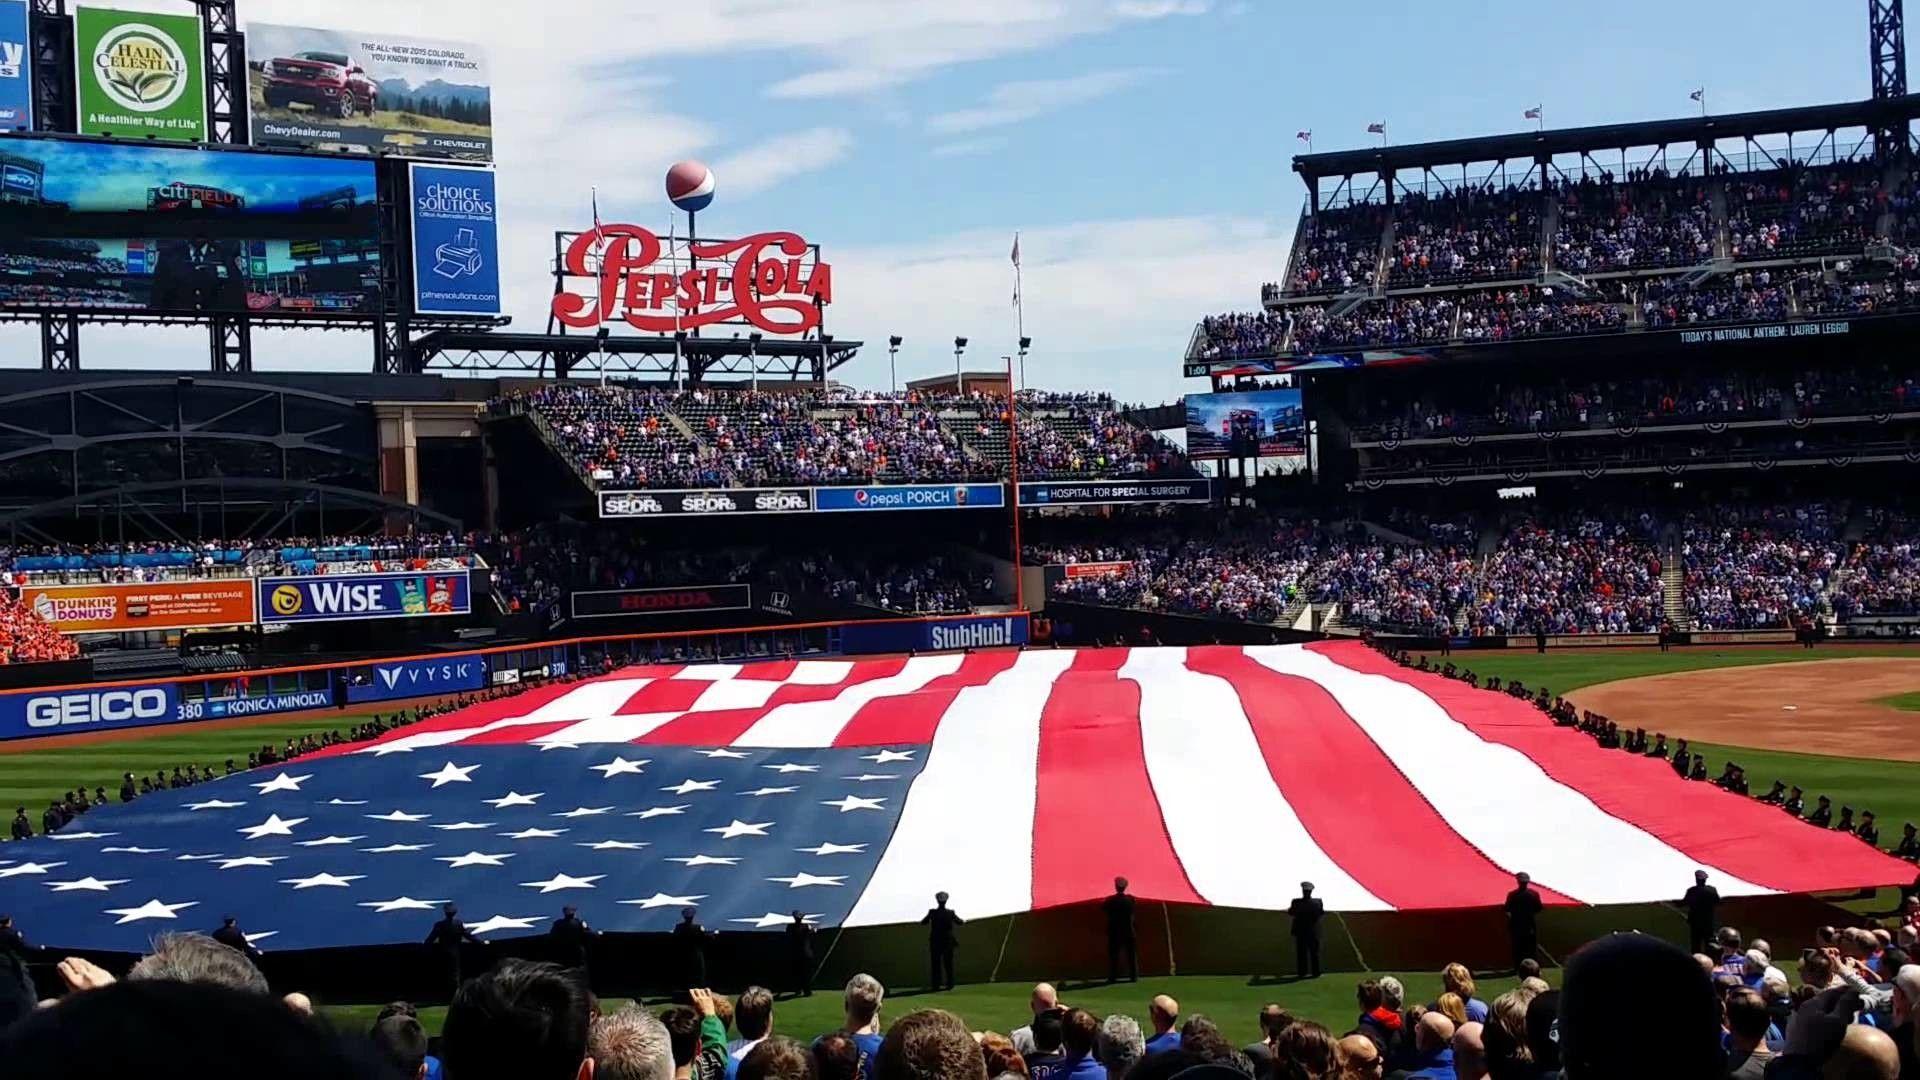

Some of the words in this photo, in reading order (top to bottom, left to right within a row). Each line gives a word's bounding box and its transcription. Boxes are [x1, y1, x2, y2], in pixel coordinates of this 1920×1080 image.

[118, 44, 162, 59] HAIN
[361, 43, 375, 51] THE
[376, 45, 409, 54] ALL-NEW
[410, 47, 426, 56] 2015
[427, 49, 465, 59] COLORADO
[96, 53, 181, 71] CELESTIAL
[371, 53, 386, 61] YOU
[387, 54, 408, 63] KNOW
[410, 56, 426, 65] YOU
[426, 58, 446, 67] WANT
[89, 113, 96, 123] A
[98, 114, 143, 126] Healthier
[144, 117, 165, 128] Way
[167, 118, 176, 128] of
[264, 124, 341, 139] ChevyDealer.com
[433, 138, 487, 149] CHEVROLET
[427, 183, 481, 201] CHOICE
[418, 197, 493, 214] SOLUTIONS
[1680, 331, 1712, 343] TODAY'S
[1714, 328, 1752, 341] NATIONAL
[1753, 326, 1788, 339] ANTHEM:
[1790, 324, 1820, 336] LAUREN
[1822, 322, 1849, 334] LEGGIO
[1188, 366, 1206, 376] 1:00
[870, 493, 904, 506] pepsi
[907, 491, 950, 504] PORCH
[1050, 488, 1092, 498] HOSPITAL
[1093, 488, 1110, 498] FOR
[1111, 487, 1149, 497] SPECIAL
[1150, 486, 1191, 496] SURGERY
[202, 591, 243, 599] BEVERAGE
[309, 582, 384, 614] WISE
[621, 591, 711, 609] HONDA
[57, 609, 113, 620] DONUTS
[762, 605, 792, 616] HONDA
[931, 618, 1013, 650] StubHub!
[552, 662, 565, 676] 370
[26, 688, 167, 728] GEICO
[227, 698, 275, 714] KONICA
[276, 692, 327, 710] MINOLTA
[176, 704, 203, 720] 380
